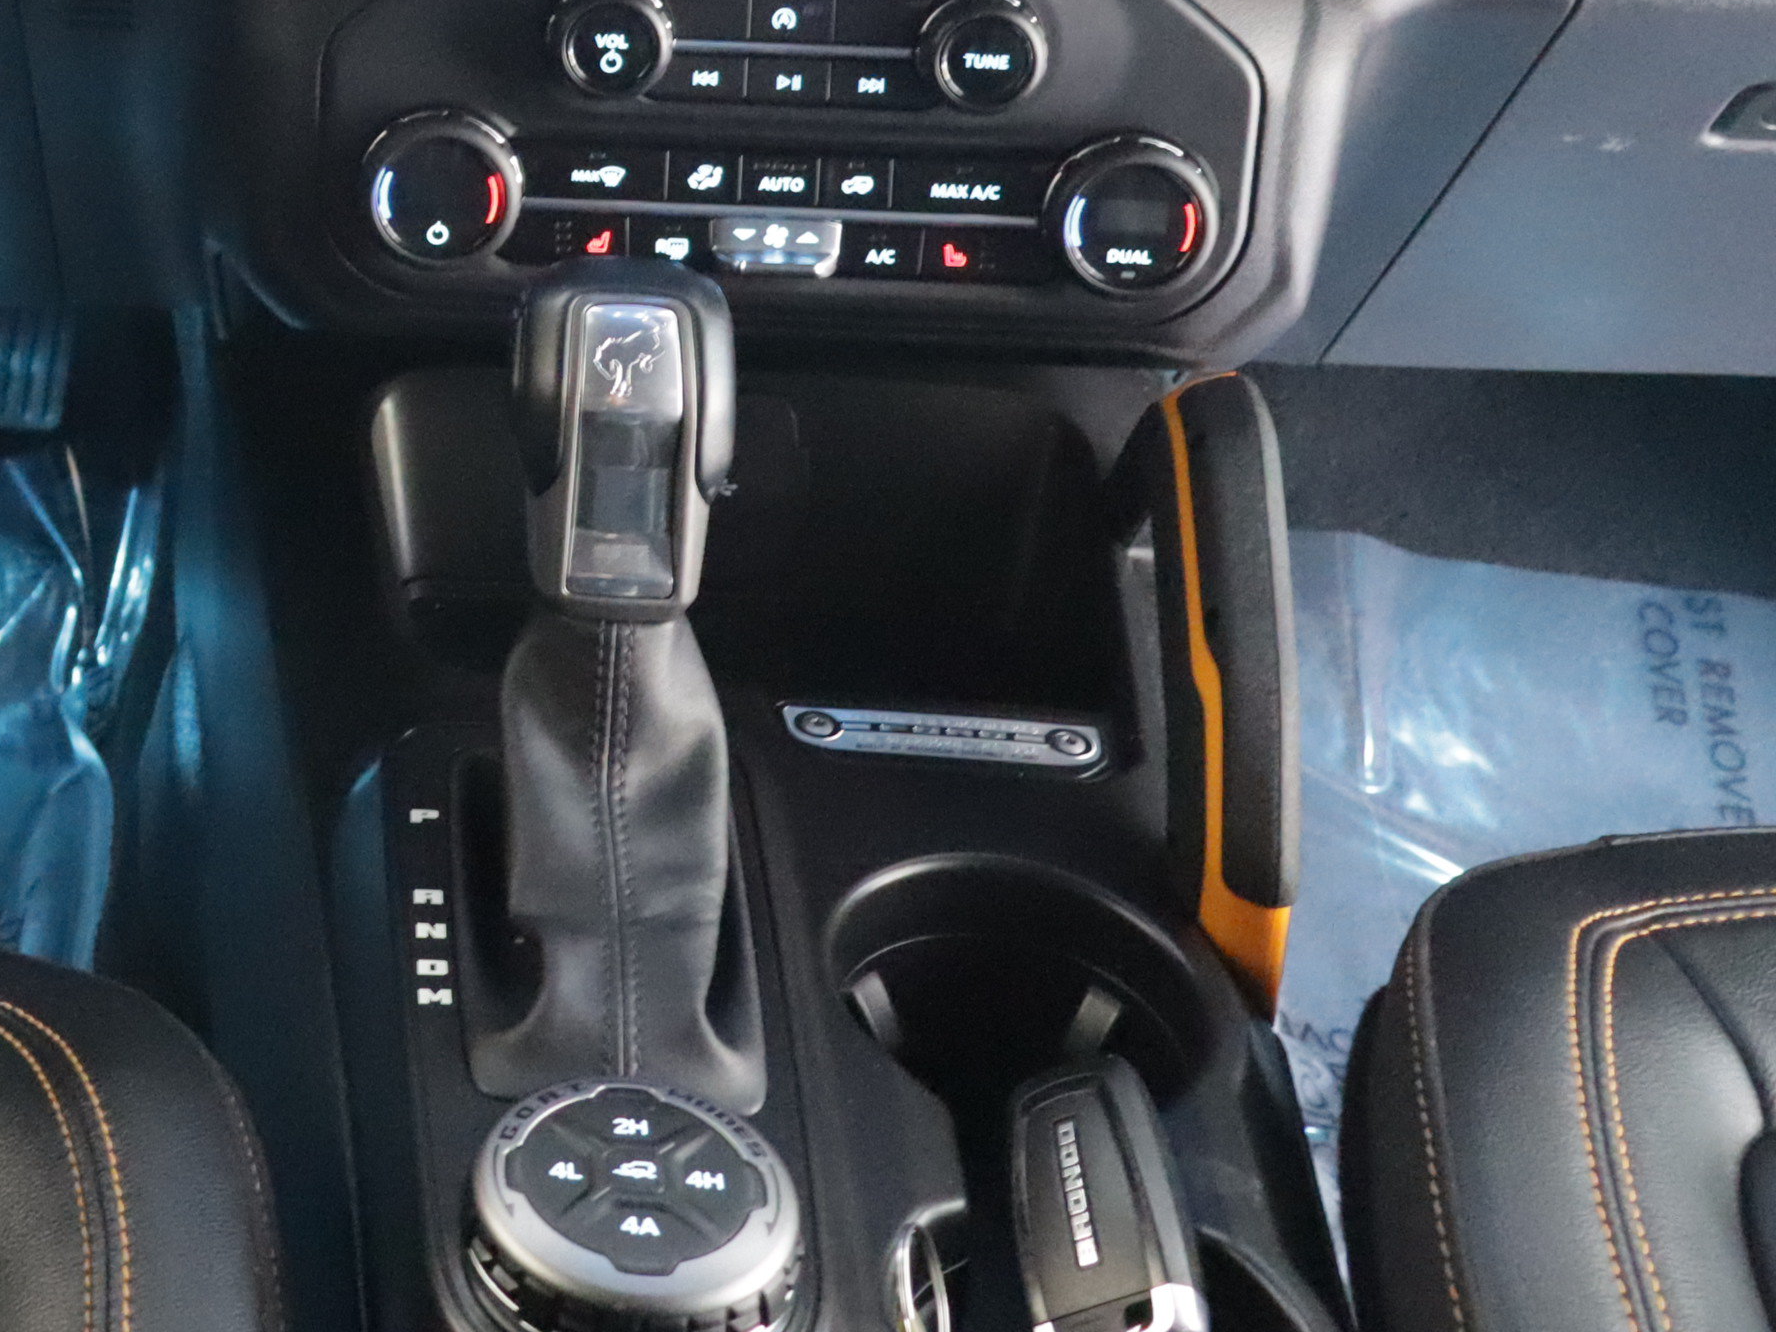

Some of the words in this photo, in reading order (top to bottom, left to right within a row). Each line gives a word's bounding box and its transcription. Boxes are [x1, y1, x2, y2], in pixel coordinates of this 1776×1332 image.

[595, 33, 629, 50] VOL
[963, 52, 1010, 70] TUNE
[571, 169, 600, 183] MAX
[758, 175, 805, 193] AUTO
[930, 182, 969, 200] MAX
[970, 184, 1001, 201] A/C
[865, 248, 895, 265] A/C
[1106, 248, 1152, 265] DUAL
[1636, 601, 1688, 727] COVER
[1697, 657, 1756, 826] REMOVE
[409, 809, 440, 824] P
[415, 922, 447, 939] N
[416, 959, 449, 976] D
[417, 988, 453, 1005] M
[612, 1117, 649, 1136] 2H
[548, 1161, 583, 1181] 4L
[685, 1170, 725, 1191] 4H
[1054, 1120, 1099, 1267] BRONCO
[620, 1215, 661, 1237] 4A
